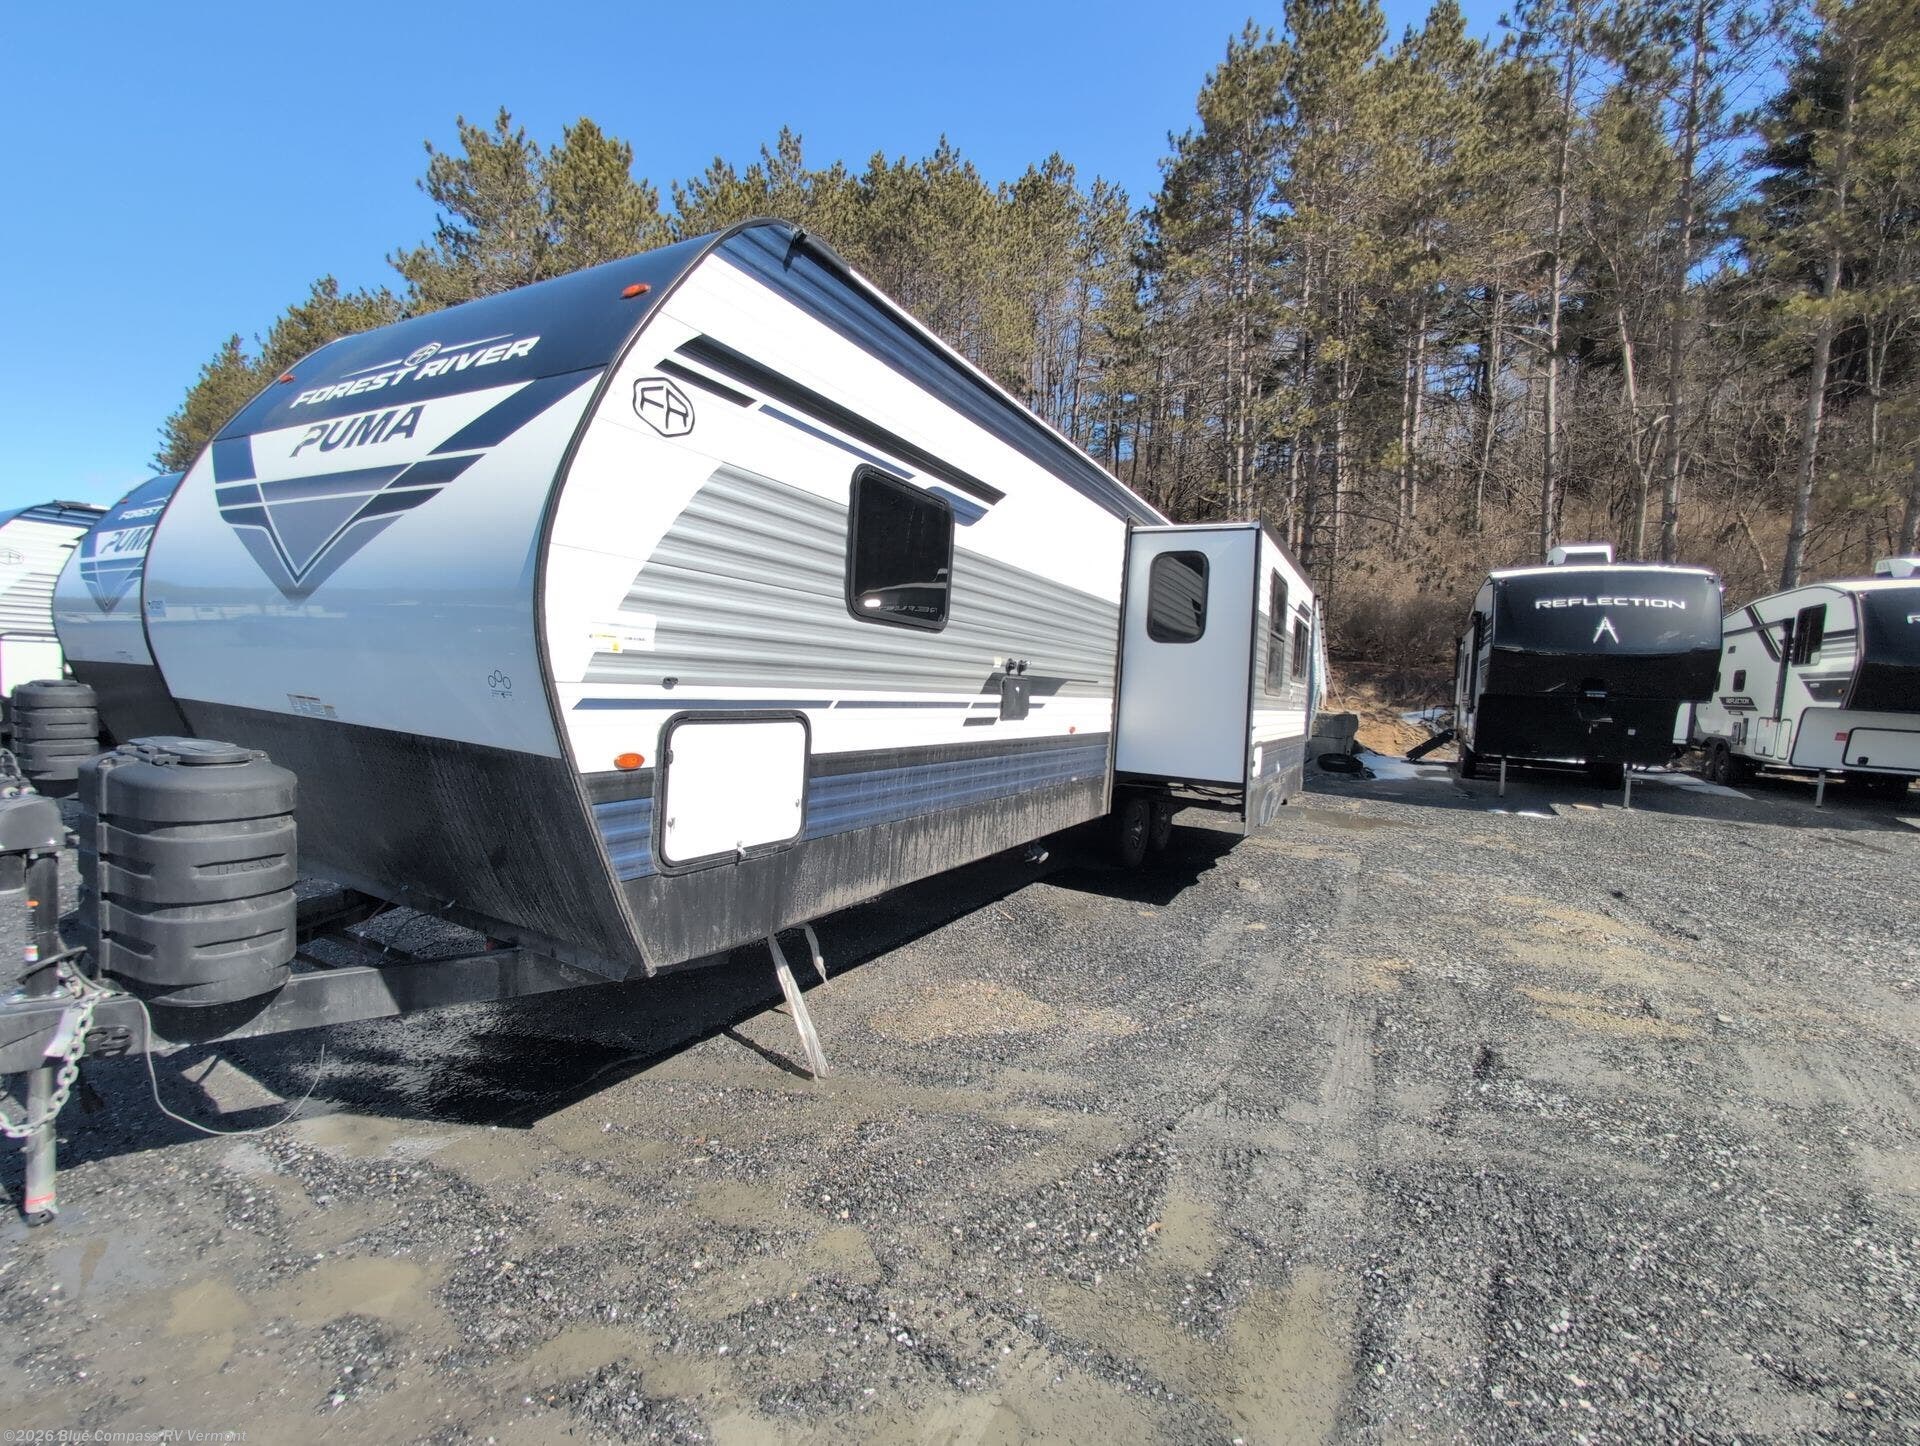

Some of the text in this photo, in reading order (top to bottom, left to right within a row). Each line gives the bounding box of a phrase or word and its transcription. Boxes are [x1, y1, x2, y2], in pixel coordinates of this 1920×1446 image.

[289, 336, 541, 409] FOREST RIVER
[289, 404, 427, 458] PUMA
[1535, 597, 1686, 610] REFLECTION
